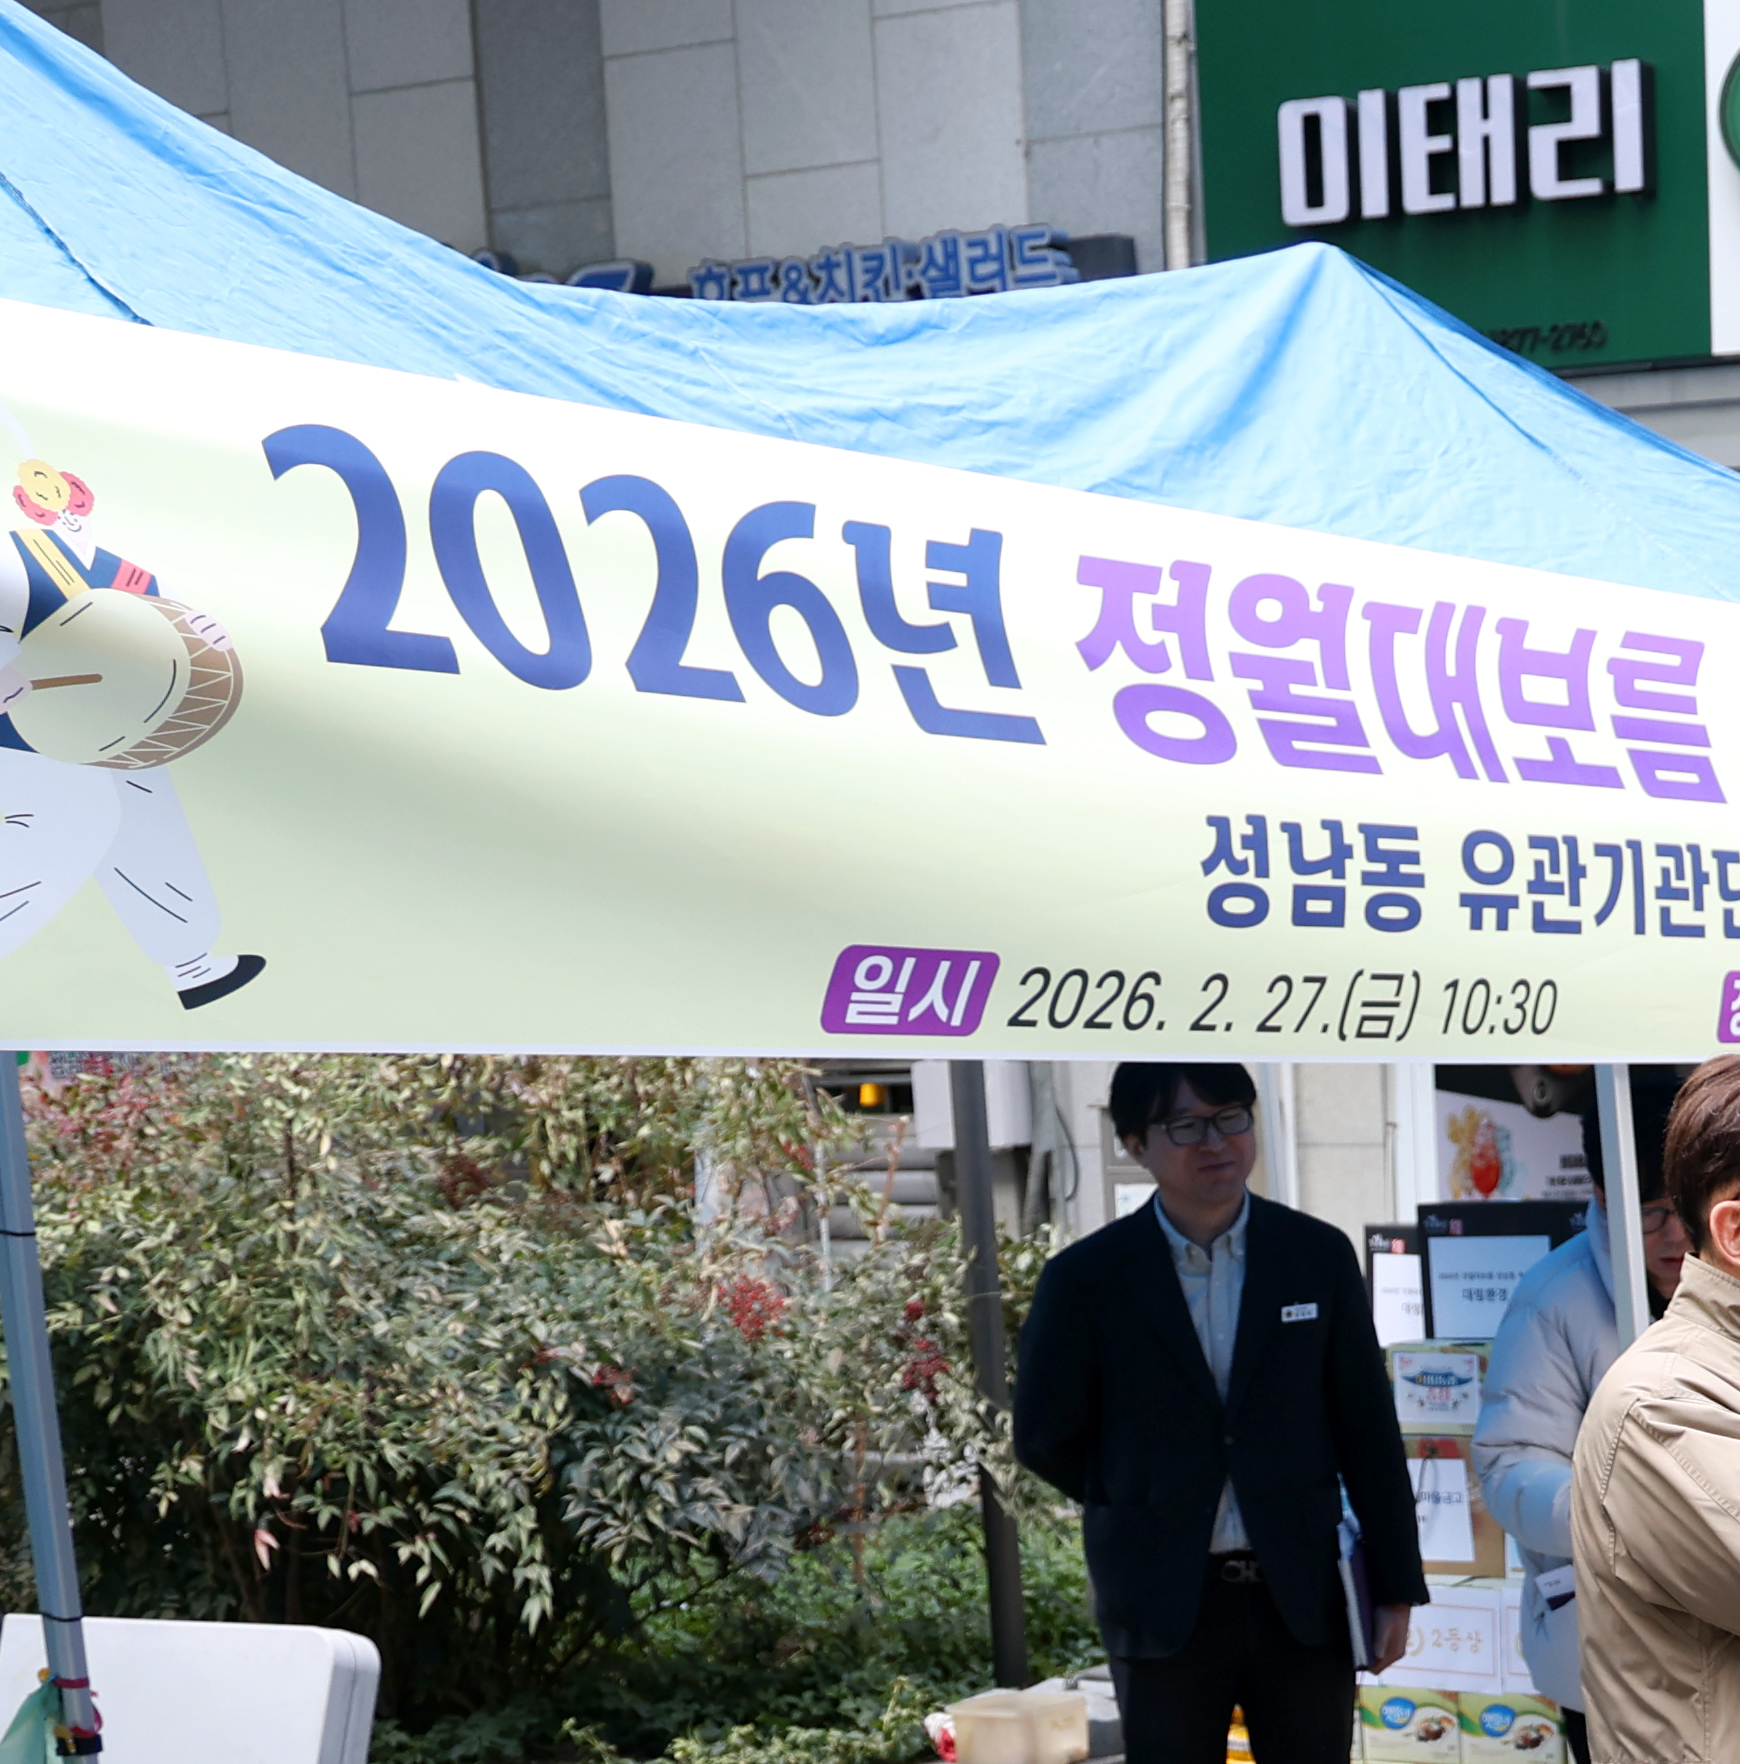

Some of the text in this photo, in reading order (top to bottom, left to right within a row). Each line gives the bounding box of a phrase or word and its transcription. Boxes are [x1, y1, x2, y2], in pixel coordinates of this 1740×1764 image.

[1276, 57, 1653, 227] 이태리
[261, 424, 1047, 745] 2026년
[1075, 554, 1728, 804] 정월대보름
[1200, 814, 1426, 932] 성남동
[844, 955, 982, 1029] 일시
[1007, 965, 1167, 1032] 2026.
[1189, 973, 1235, 1033] 2.
[1440, 977, 1557, 1035] 10:30
[1430, 1627, 1485, 1654] 2등상
